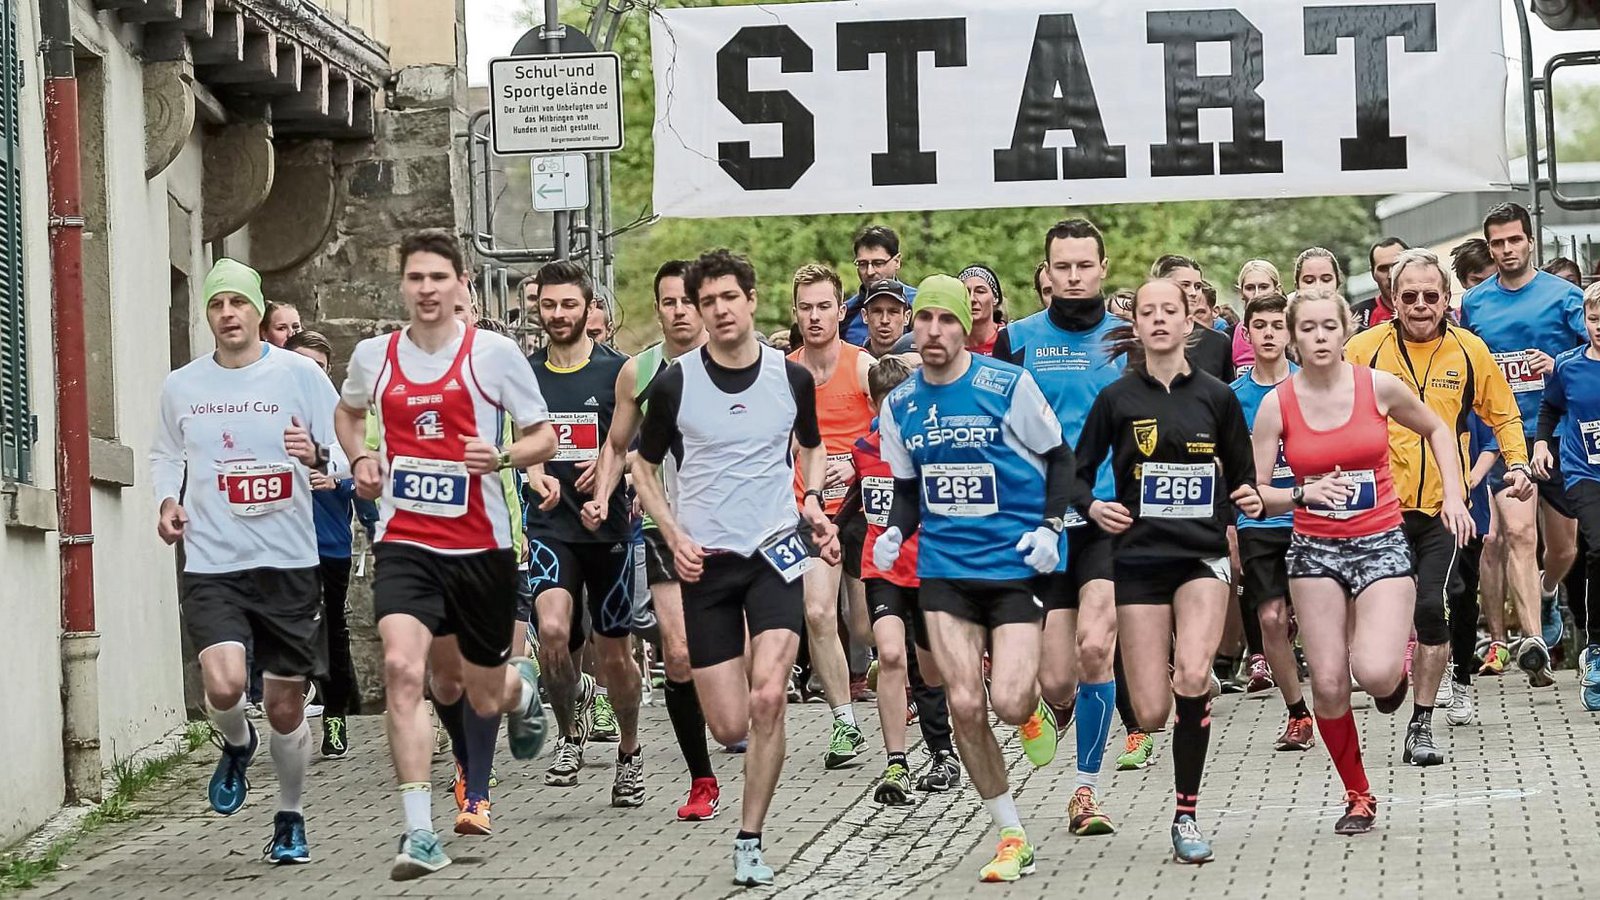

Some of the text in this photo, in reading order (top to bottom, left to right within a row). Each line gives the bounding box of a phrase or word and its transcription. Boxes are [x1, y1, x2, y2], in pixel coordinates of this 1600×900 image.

[515, 63, 594, 80] Schul-und
[503, 82, 607, 101] Sportgelände
[716, 3, 1437, 190] START
[504, 105, 515, 114] Der
[518, 104, 540, 113] Zutritt
[556, 103, 594, 112] Unbefugten
[596, 101, 608, 110] und
[524, 115, 536, 123] das
[538, 114, 574, 123] Mitbringen
[513, 125, 537, 134] Hunden
[540, 125, 548, 133] ist
[551, 124, 567, 132] nicht
[191, 401, 279, 414] Volkslauf Cup
[560, 425, 573, 444] 2
[927, 427, 999, 446] SPORT
[951, 441, 988, 449] ASPERG
[237, 476, 282, 501] 169
[404, 474, 455, 502] 303
[936, 476, 983, 499] 262
[1155, 477, 1202, 499] 266
